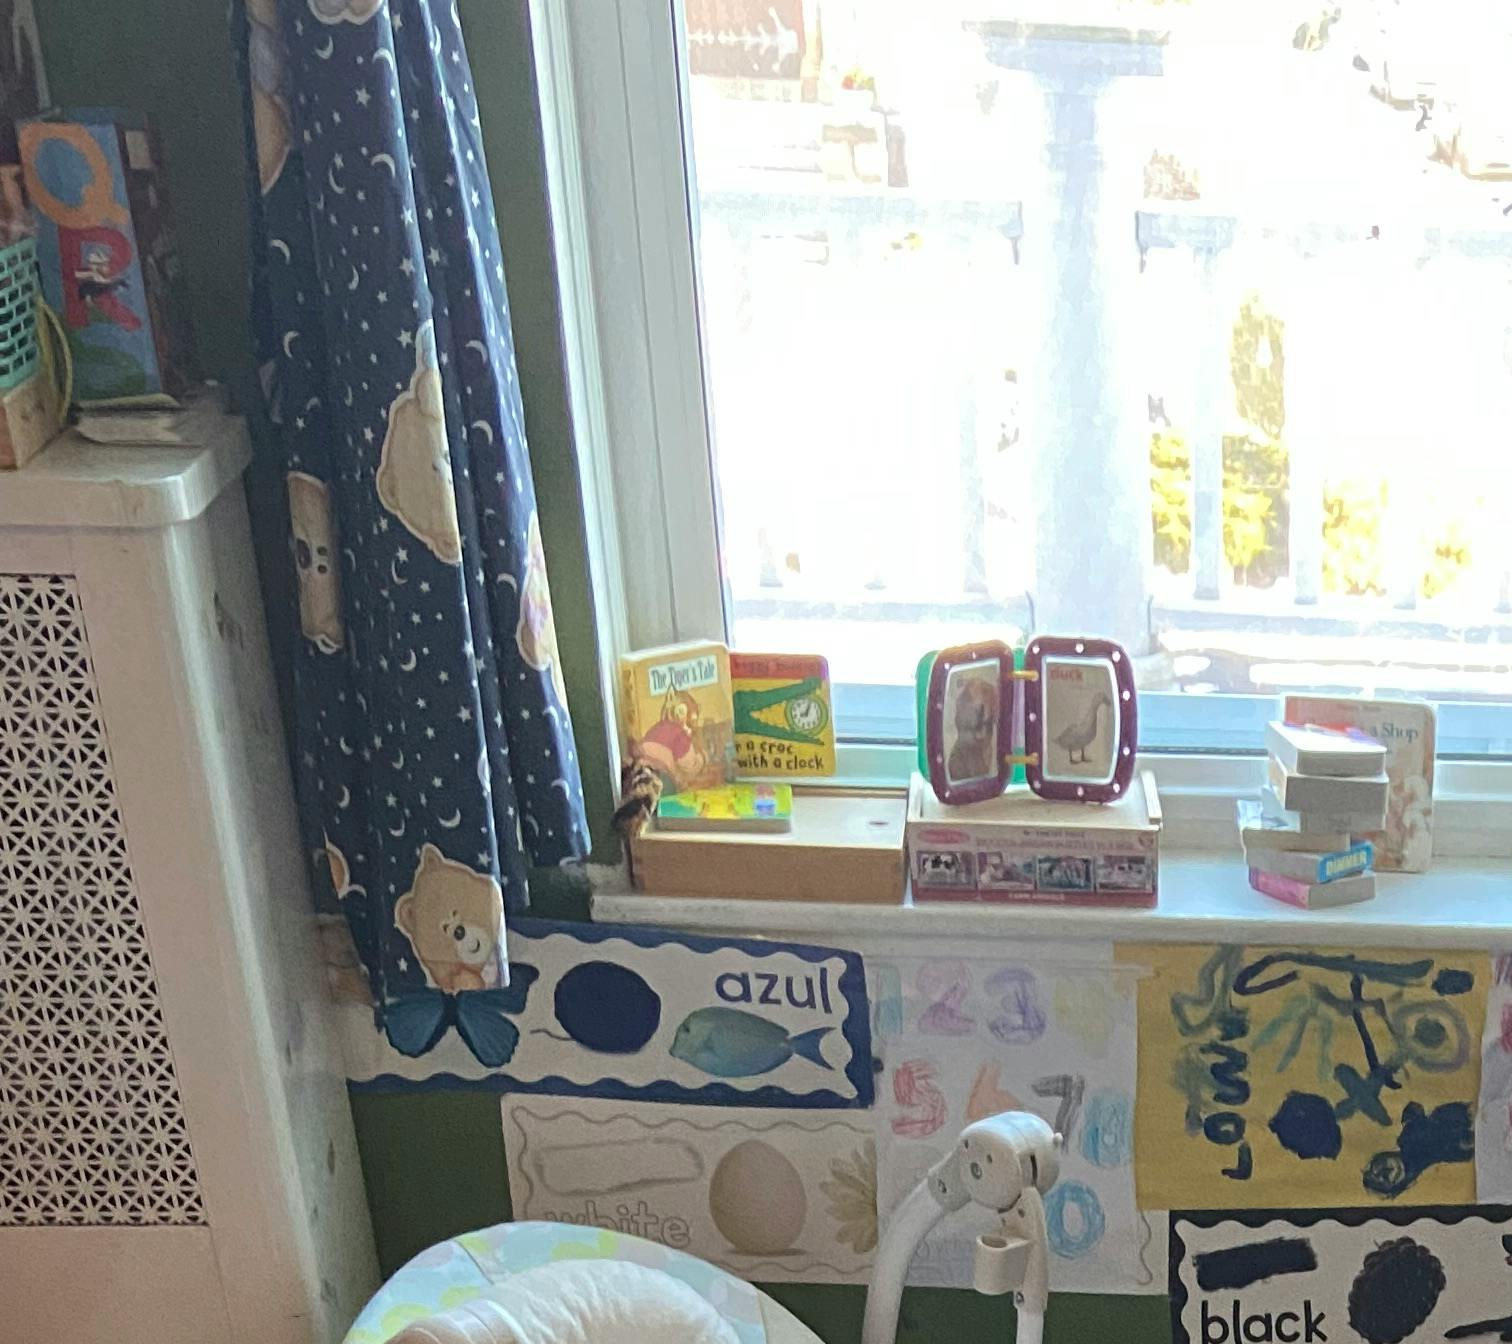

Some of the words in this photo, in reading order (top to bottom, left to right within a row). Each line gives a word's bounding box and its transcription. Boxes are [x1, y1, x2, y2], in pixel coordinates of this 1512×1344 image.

[58, 226, 142, 332] R
[1050, 667, 1083, 681] duck
[1381, 722, 1419, 742] Shop
[761, 741, 792, 755] croc
[738, 754, 768, 768] with
[786, 754, 824, 770] clock
[1326, 852, 1367, 874] DINNER
[715, 967, 833, 1014] azul
[891, 1058, 947, 1139] 5
[1031, 1071, 1086, 1154] 7
